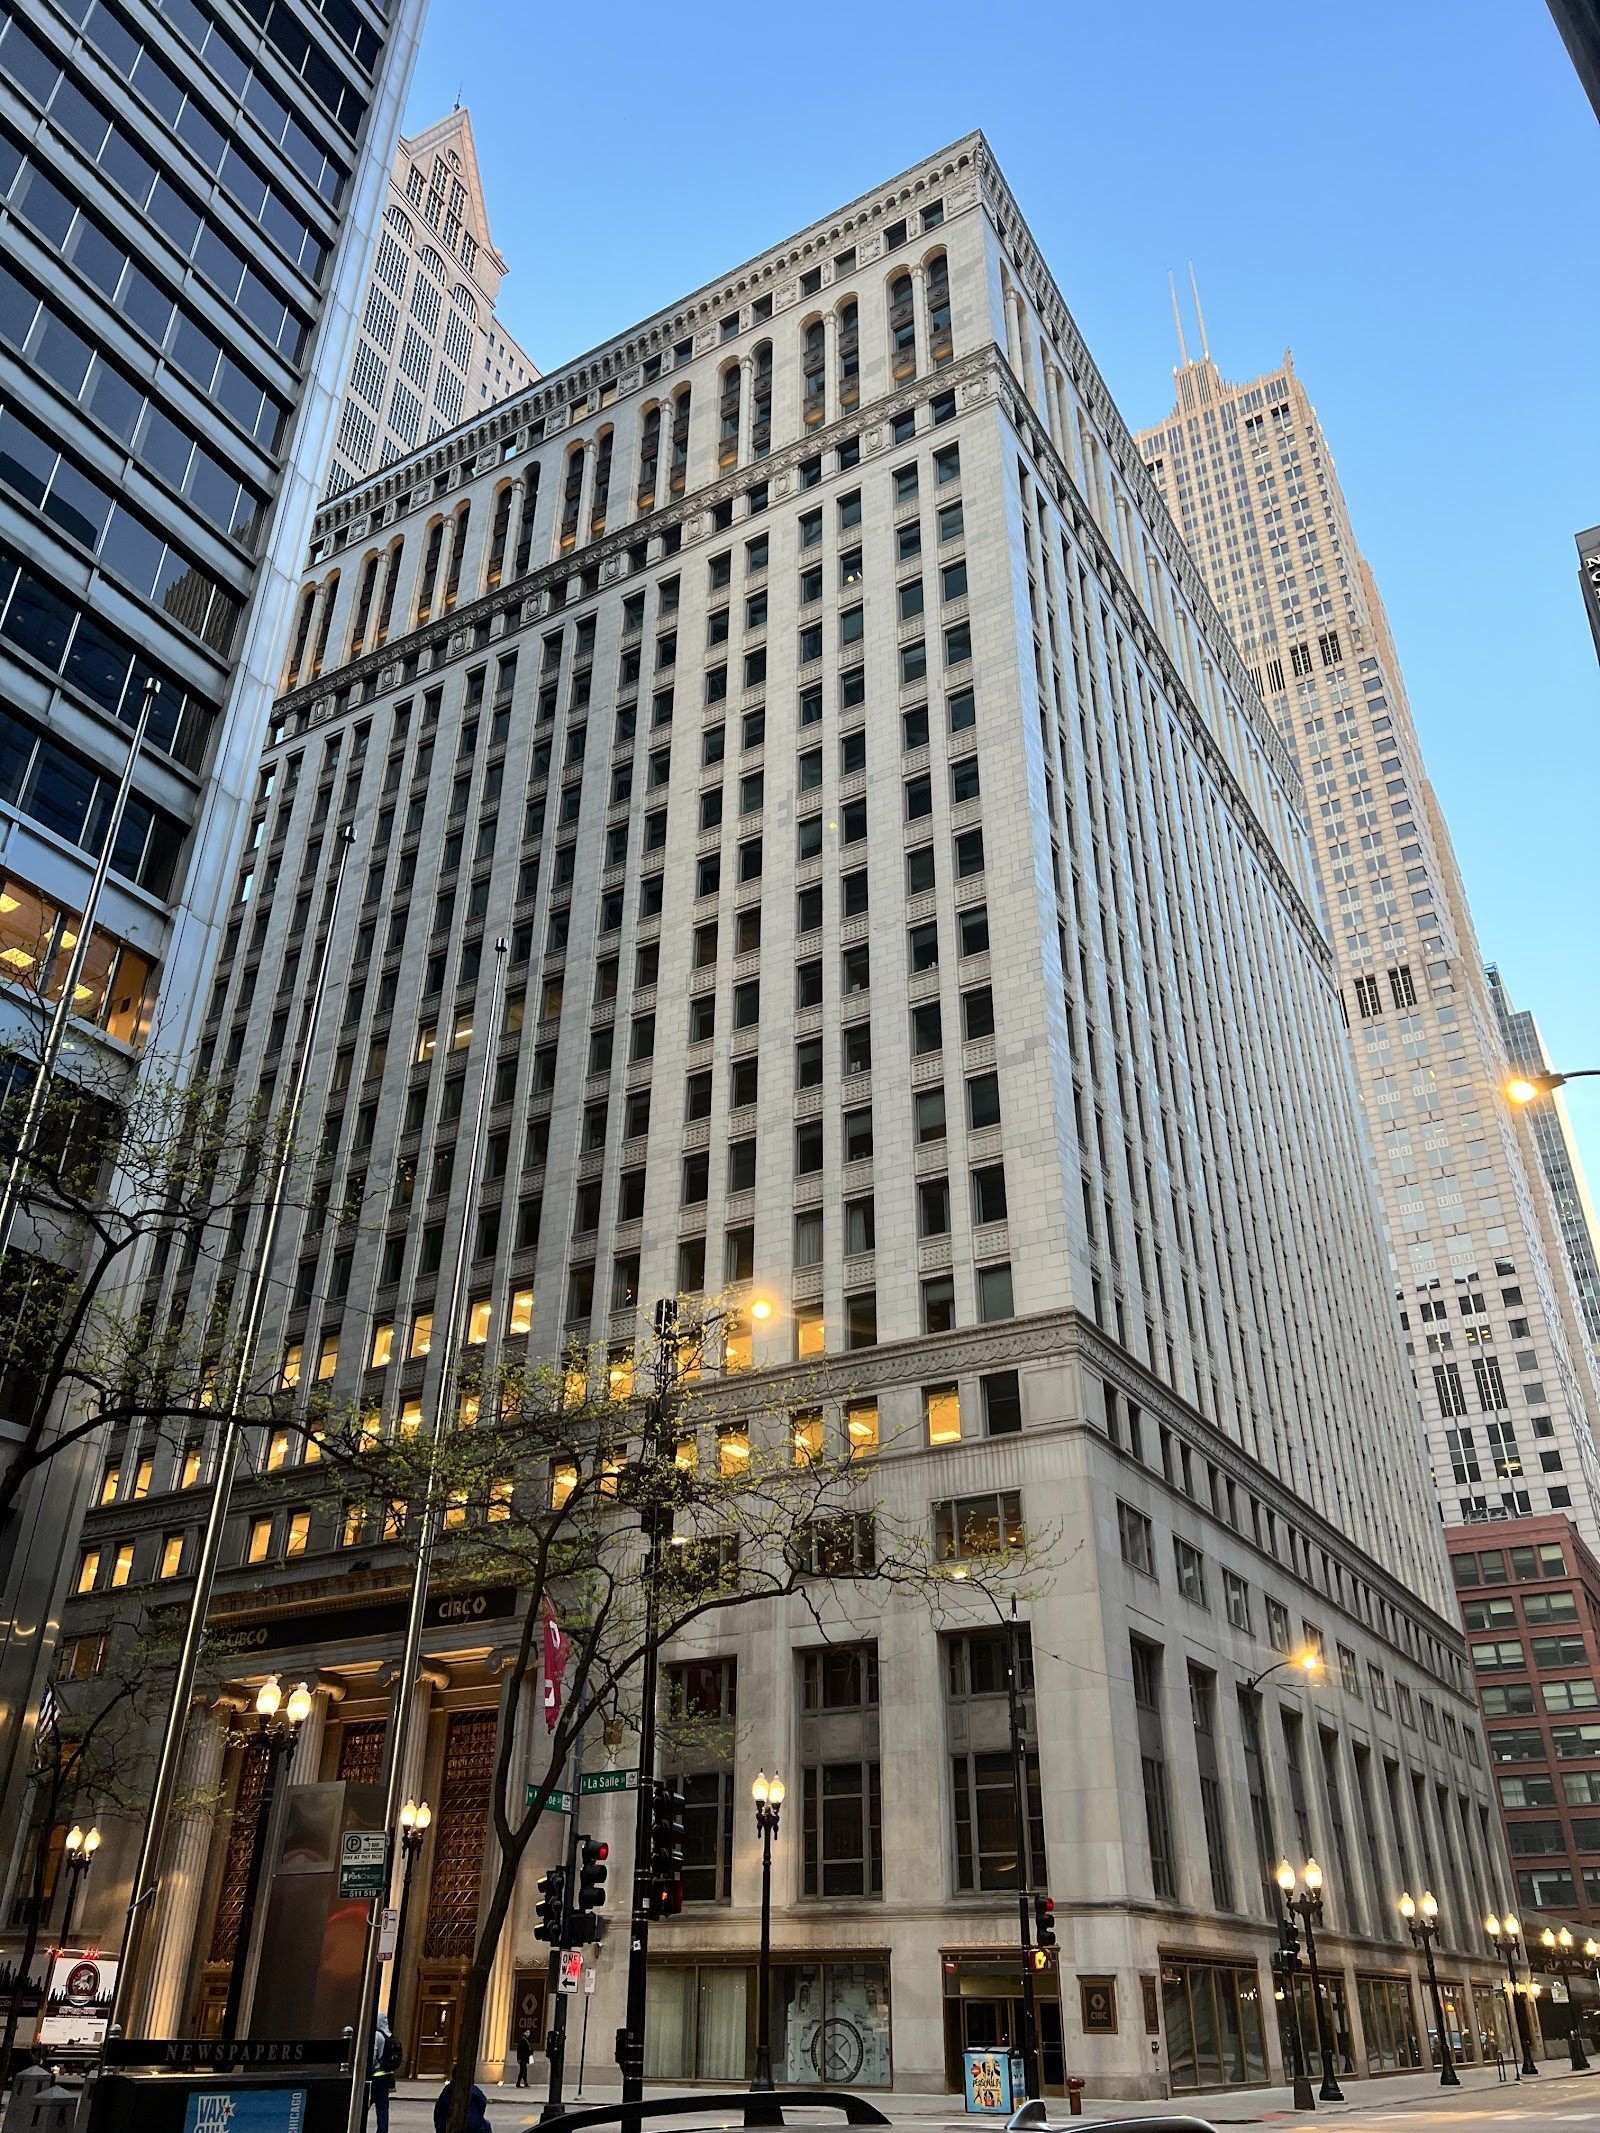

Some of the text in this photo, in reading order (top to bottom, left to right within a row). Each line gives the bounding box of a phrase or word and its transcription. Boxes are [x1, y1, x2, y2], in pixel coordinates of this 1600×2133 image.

[439, 1600, 472, 1618] CIBC
[588, 1777, 598, 1789] La
[599, 1775, 620, 1788] Salle
[562, 1953, 579, 1964] ONE
[561, 1965, 579, 1976] WAY
[1090, 2011, 1108, 2020] CIBC
[518, 2017, 539, 2029] CIBC
[165, 2044, 304, 2061] NEWSPAPERS
